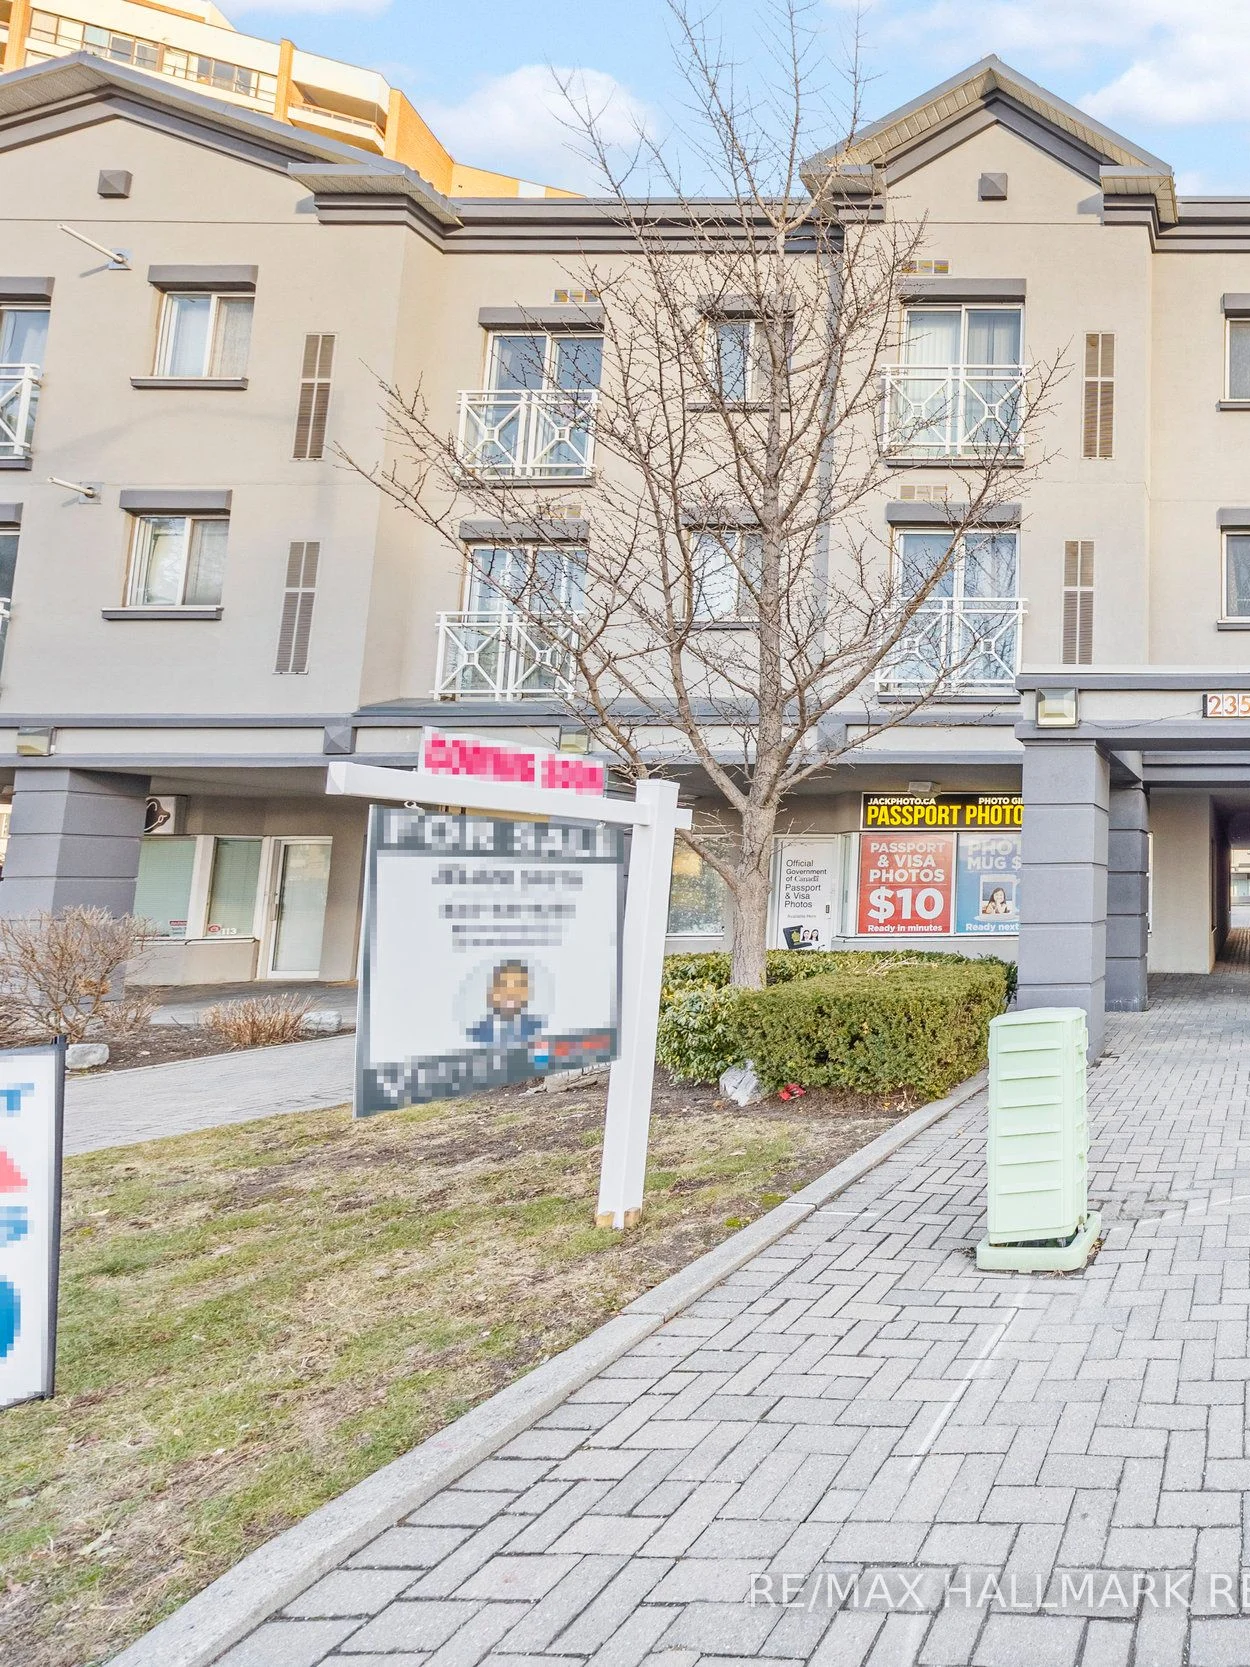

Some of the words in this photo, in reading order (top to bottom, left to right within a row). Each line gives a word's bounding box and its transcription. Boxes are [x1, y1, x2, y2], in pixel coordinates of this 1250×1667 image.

[868, 797, 936, 805] JACKPHOTO.CA
[978, 797, 1010, 805] PHOTO
[867, 806, 961, 825] PASSPORT
[965, 805, 1023, 825] PHOTO
[870, 842, 946, 853] PASSPORT
[877, 855, 889, 867] &
[894, 854, 936, 867] VISA
[967, 857, 1006, 870] MUG
[869, 869, 945, 882] PHOTOS
[785, 884, 821, 893] Passport
[867, 886, 944, 923] $10
[868, 924, 896, 933] Ready
[898, 924, 906, 932] in
[908, 924, 942, 932] minutes
[966, 923, 995, 932] Ready
